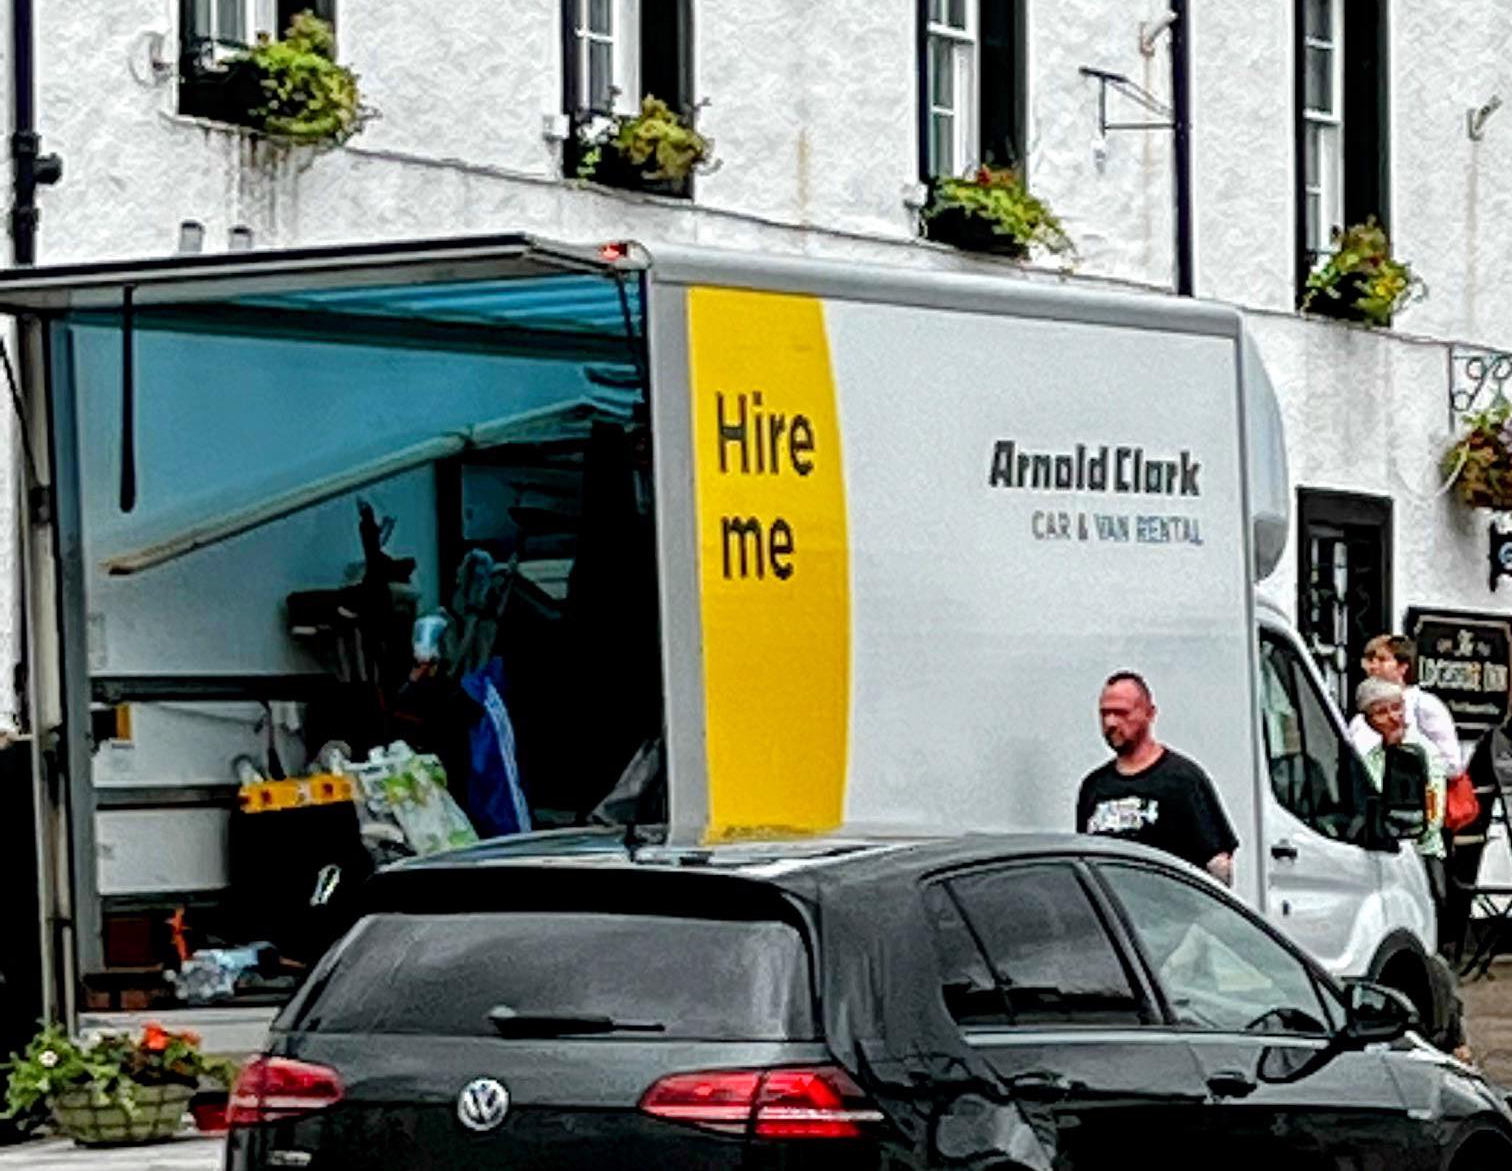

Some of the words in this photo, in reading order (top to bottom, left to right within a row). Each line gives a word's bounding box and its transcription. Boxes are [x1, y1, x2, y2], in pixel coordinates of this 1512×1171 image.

[716, 392, 815, 476] Hire
[989, 440, 1108, 491] Arnold
[1114, 447, 1200, 496] Clark
[722, 516, 794, 579] me
[1032, 510, 1071, 540] CAR
[1094, 514, 1129, 541] VAN
[1136, 515, 1203, 545] RENTAL
